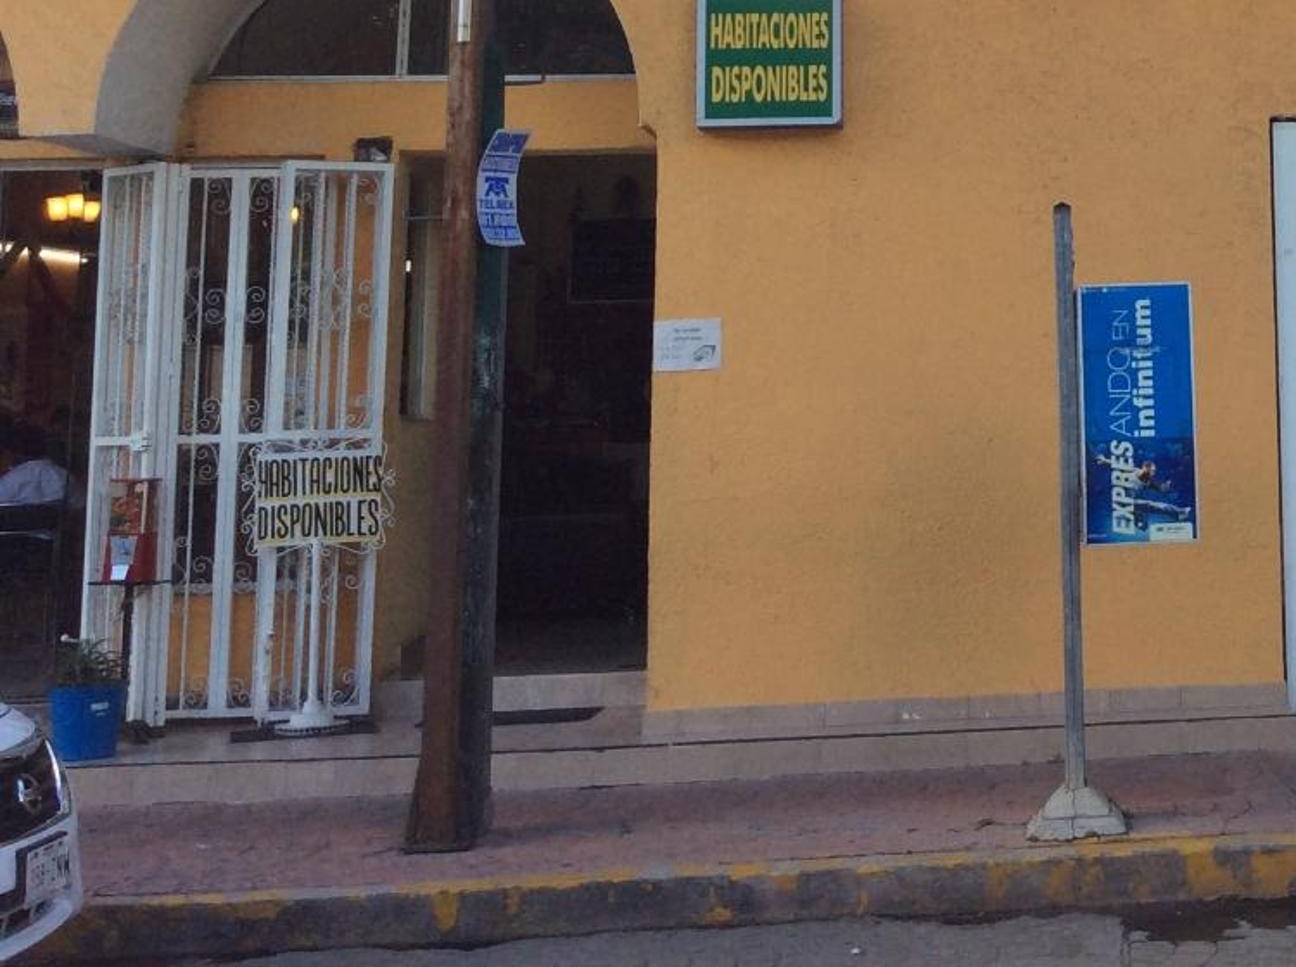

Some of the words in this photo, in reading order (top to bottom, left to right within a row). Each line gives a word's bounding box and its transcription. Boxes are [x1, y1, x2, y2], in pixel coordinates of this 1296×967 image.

[710, 12, 829, 49] HABITACIONES
[711, 65, 827, 103] DISPONIBLES
[1112, 309, 1130, 341] EN
[1132, 298, 1156, 438] infinitum
[258, 455, 382, 499] HABITACIONES
[258, 499, 380, 541] DISPONIBLES
